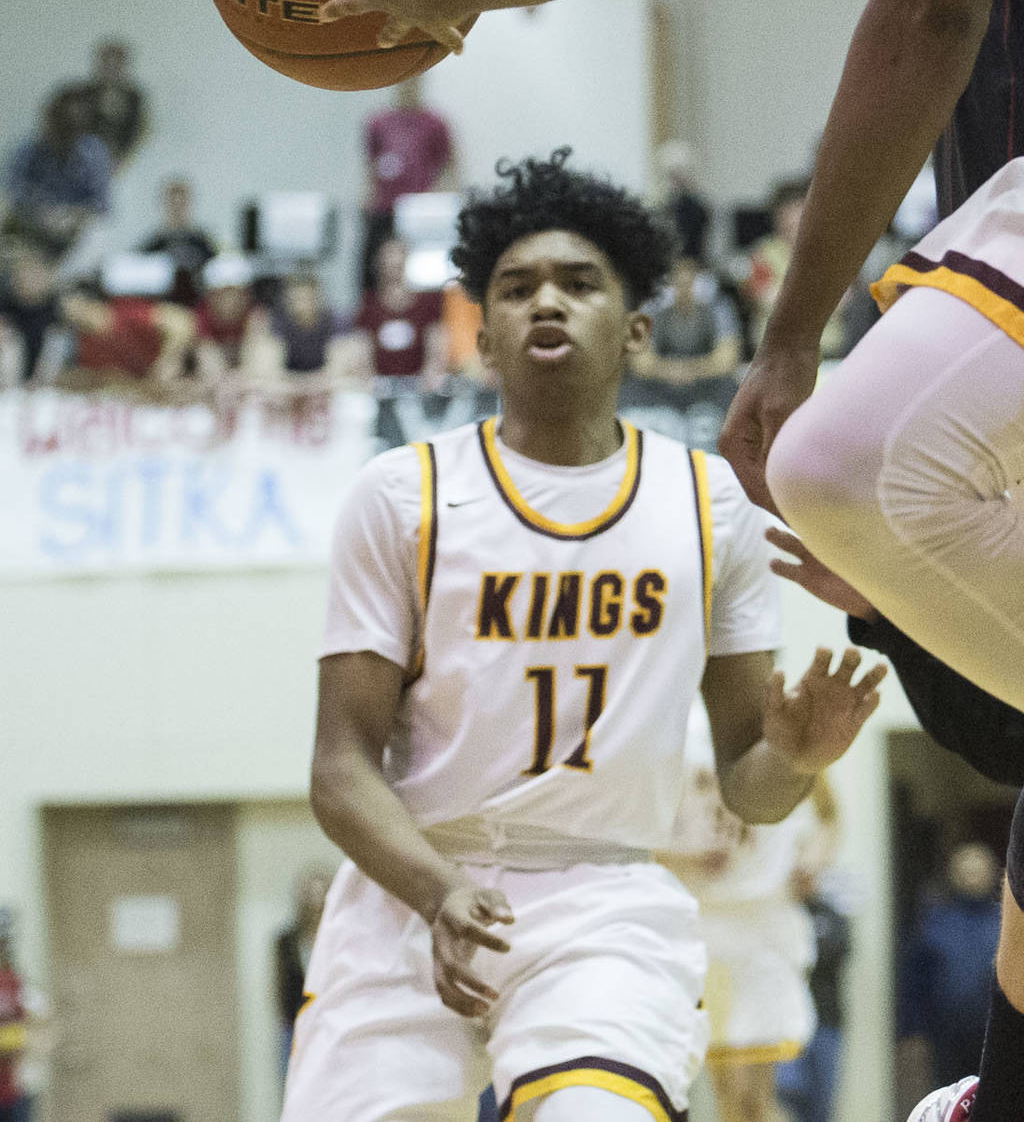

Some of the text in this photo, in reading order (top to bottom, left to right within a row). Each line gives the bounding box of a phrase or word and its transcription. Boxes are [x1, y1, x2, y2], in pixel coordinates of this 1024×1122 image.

[38, 456, 305, 560] SITKA
[475, 568, 668, 642] KINGS
[521, 664, 609, 776] 11
